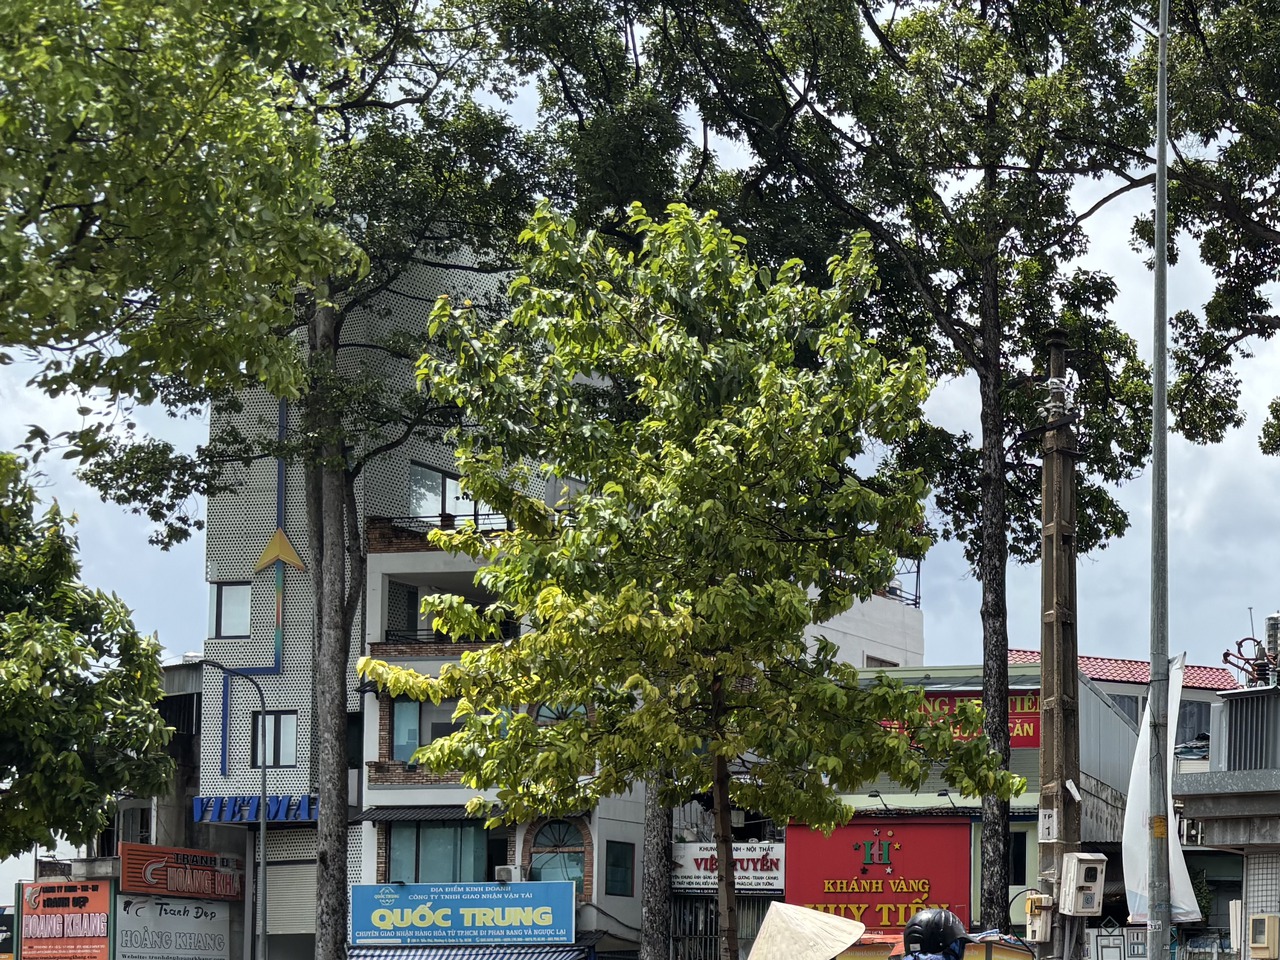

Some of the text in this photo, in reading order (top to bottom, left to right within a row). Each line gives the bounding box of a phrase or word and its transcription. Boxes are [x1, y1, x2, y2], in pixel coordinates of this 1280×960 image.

[193, 795, 320, 822] VIETMA
[1045, 826, 1050, 836] 1
[759, 844, 774, 852] THẤT
[174, 852, 217, 867] TRANH
[693, 852, 781, 873] VIỆ TUYẾN
[167, 864, 211, 893] HOÀNG
[823, 876, 930, 893] KHÁNH VÀNG
[155, 902, 190, 917] Tranh
[371, 902, 553, 930] QUỐC TRUNG
[64, 912, 108, 938] KHANG
[396, 930, 413, 938] NHẬN
[121, 926, 172, 949] HOÀNG
[175, 932, 225, 951] KHANG
